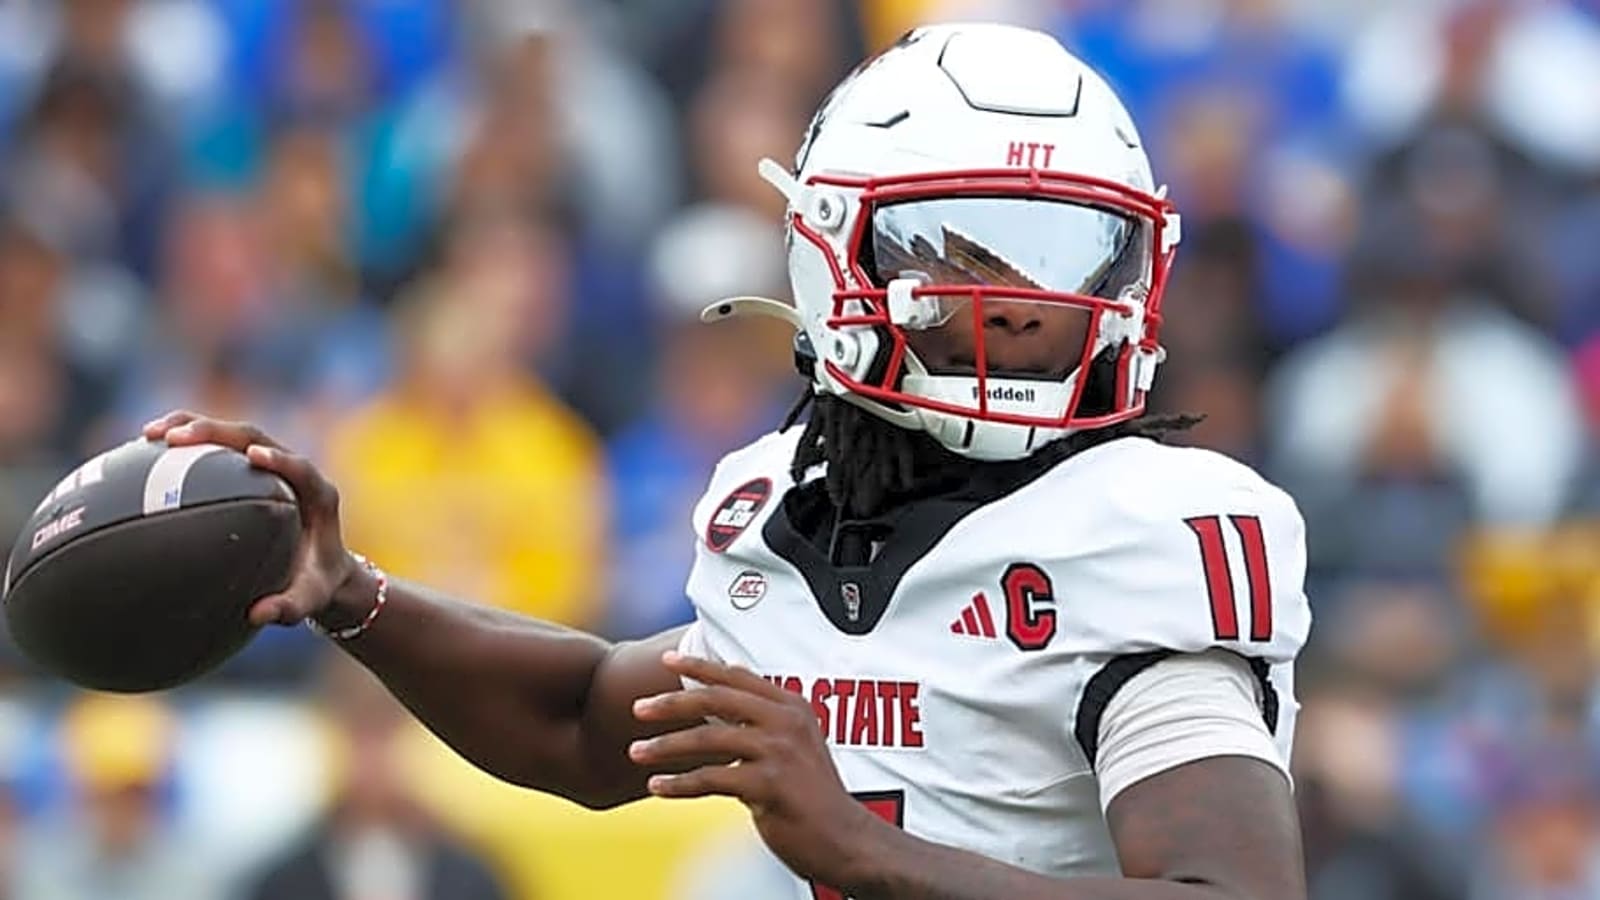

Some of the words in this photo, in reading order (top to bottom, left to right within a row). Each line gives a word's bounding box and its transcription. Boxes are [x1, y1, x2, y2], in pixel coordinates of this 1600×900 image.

[1006, 141, 1056, 168] HTT
[31, 505, 86, 550] DIME
[735, 580, 766, 595] ACC
[1000, 562, 1057, 651] C
[1183, 515, 1272, 642] 11
[811, 678, 924, 747] STATE
